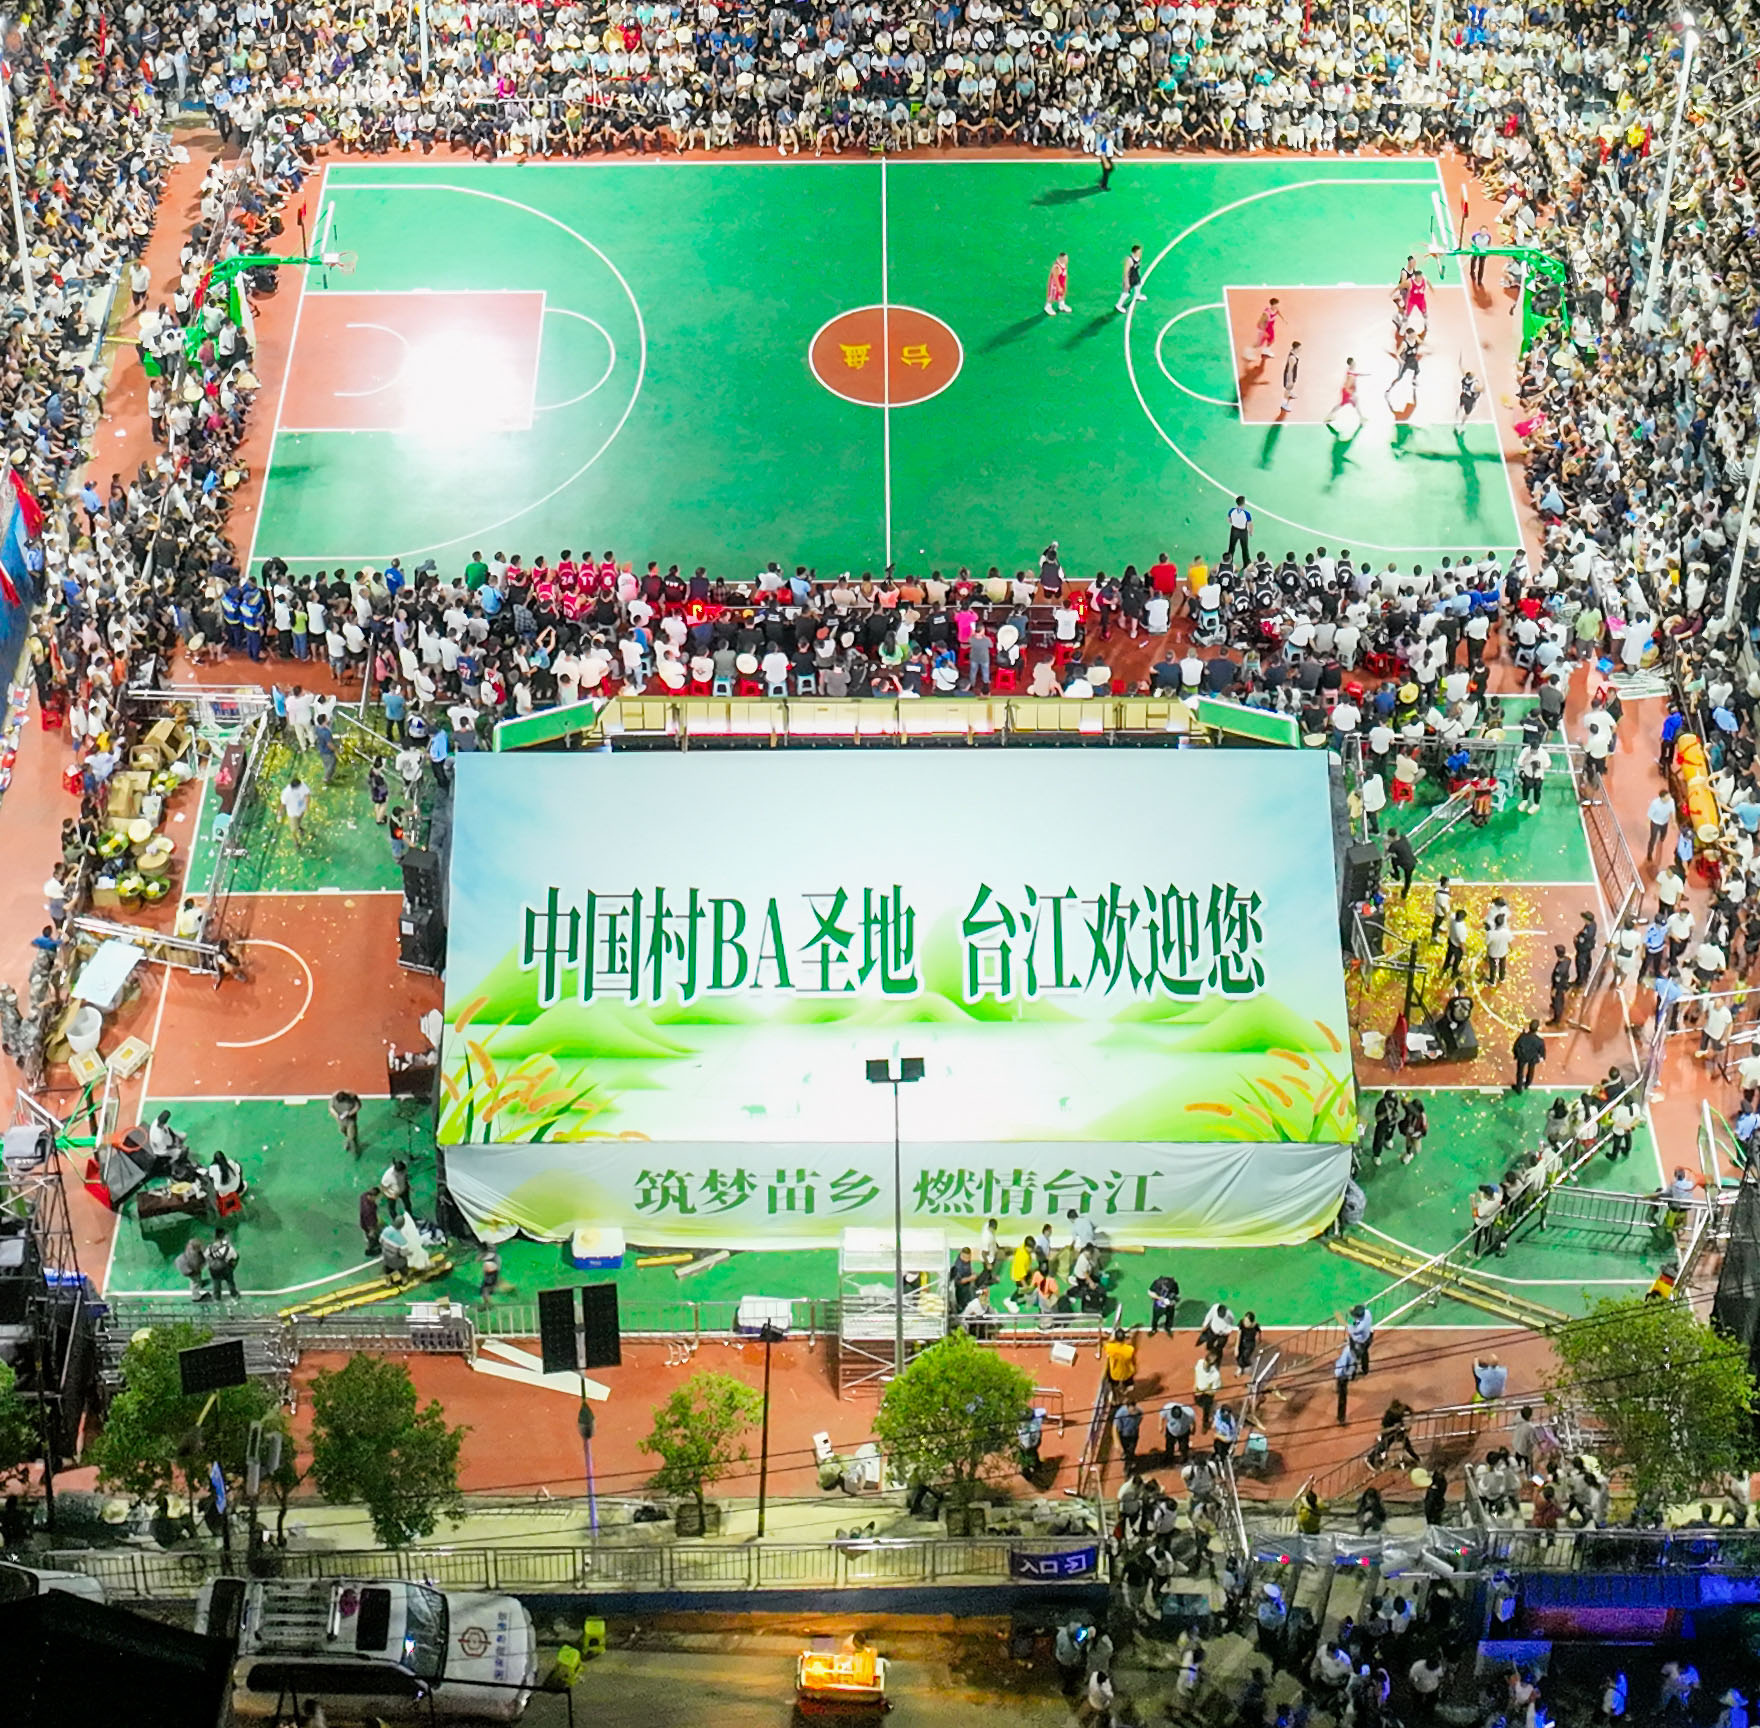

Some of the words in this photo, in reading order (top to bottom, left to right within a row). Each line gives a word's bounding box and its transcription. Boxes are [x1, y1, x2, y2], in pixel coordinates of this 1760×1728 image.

[521, 884, 918, 1003] 中国村BA圣地
[962, 882, 1266, 1000] 台江欢迎您
[634, 1168, 881, 1216] 筑梦苗乡
[913, 1167, 1164, 1217] 燃情台江
[1018, 1559, 1059, 1575] 入口
